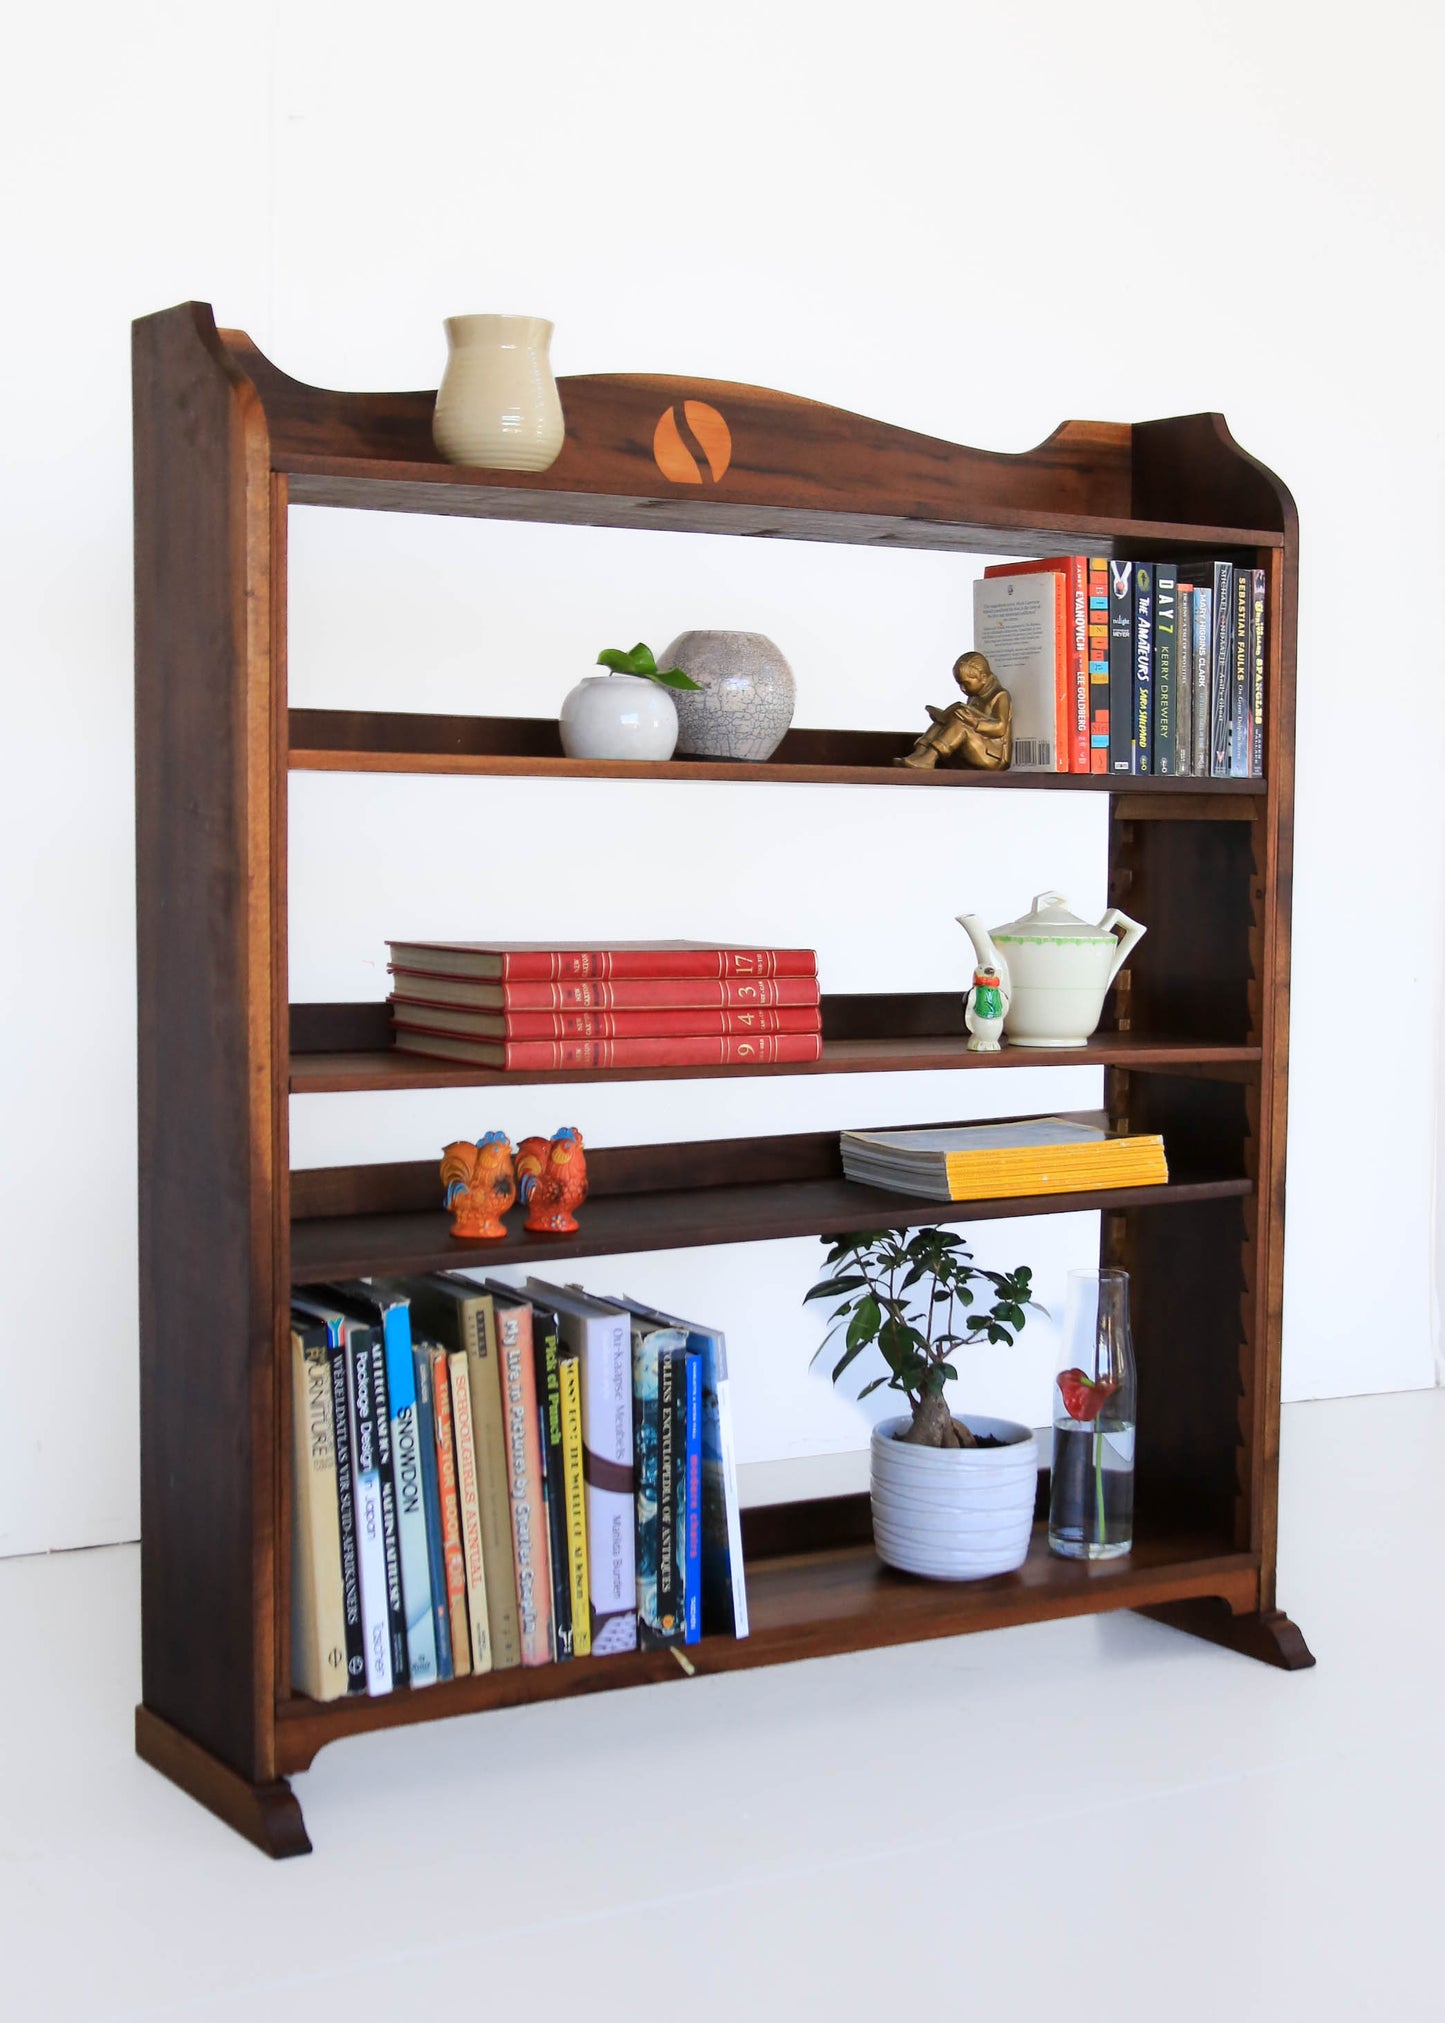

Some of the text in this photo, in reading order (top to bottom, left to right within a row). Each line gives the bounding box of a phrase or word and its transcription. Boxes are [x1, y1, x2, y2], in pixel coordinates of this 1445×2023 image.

[1075, 591, 1085, 650] EVANOVICH
[1159, 579, 1174, 619] DAY
[1199, 594, 1207, 618] MARY
[1238, 577, 1246, 637] SEBASTIAN
[1077, 671, 1085, 685] LEE
[1137, 597, 1151, 748] THE AMATEURS SARA SHEPARD
[1160, 646, 1169, 681] KERRY
[1198, 658, 1206, 687] CLARK
[1237, 642, 1245, 681] FAULKS
[1077, 687, 1086, 731] GOLDBERG
[1160, 684, 1168, 738] DREWERY
[1254, 658, 1263, 725] SPANGLES
[734, 955, 753, 974] 17
[582, 983, 590, 1006] CAXTON
[738, 986, 756, 998] 3
[737, 1013, 755, 1026] 4
[737, 1043, 755, 1056] 9
[502, 1320, 518, 1346] My
[356, 1351, 369, 1418] Package
[508, 1349, 521, 1381] Life
[440, 1381, 450, 1415] THE
[511, 1384, 521, 1401] in
[545, 1335, 562, 1445] Pick of Punch
[360, 1421, 373, 1472] Design
[442, 1420, 455, 1488] VICTOR
[511, 1406, 526, 1474] Pictures
[615, 1404, 625, 1460] Meubels
[339, 1464, 350, 1492] VIR
[396, 1407, 419, 1514] SNOWDON
[662, 1408, 671, 1504] ENCYCLOPEDIA
[456, 1376, 476, 1504] SCHOOLGIRLS
[467, 1510, 482, 1590] ANNUAL
[511, 1479, 528, 1499] by
[689, 1454, 699, 1509] modern
[365, 1496, 377, 1539] Japan
[516, 1503, 531, 1565] Charles
[662, 1506, 670, 1524] OF
[689, 1512, 700, 1558] chairs
[661, 1526, 670, 1593] ANTIQUES
[519, 1568, 537, 1633] Chaplin
[371, 1622, 385, 1681] Taschen
